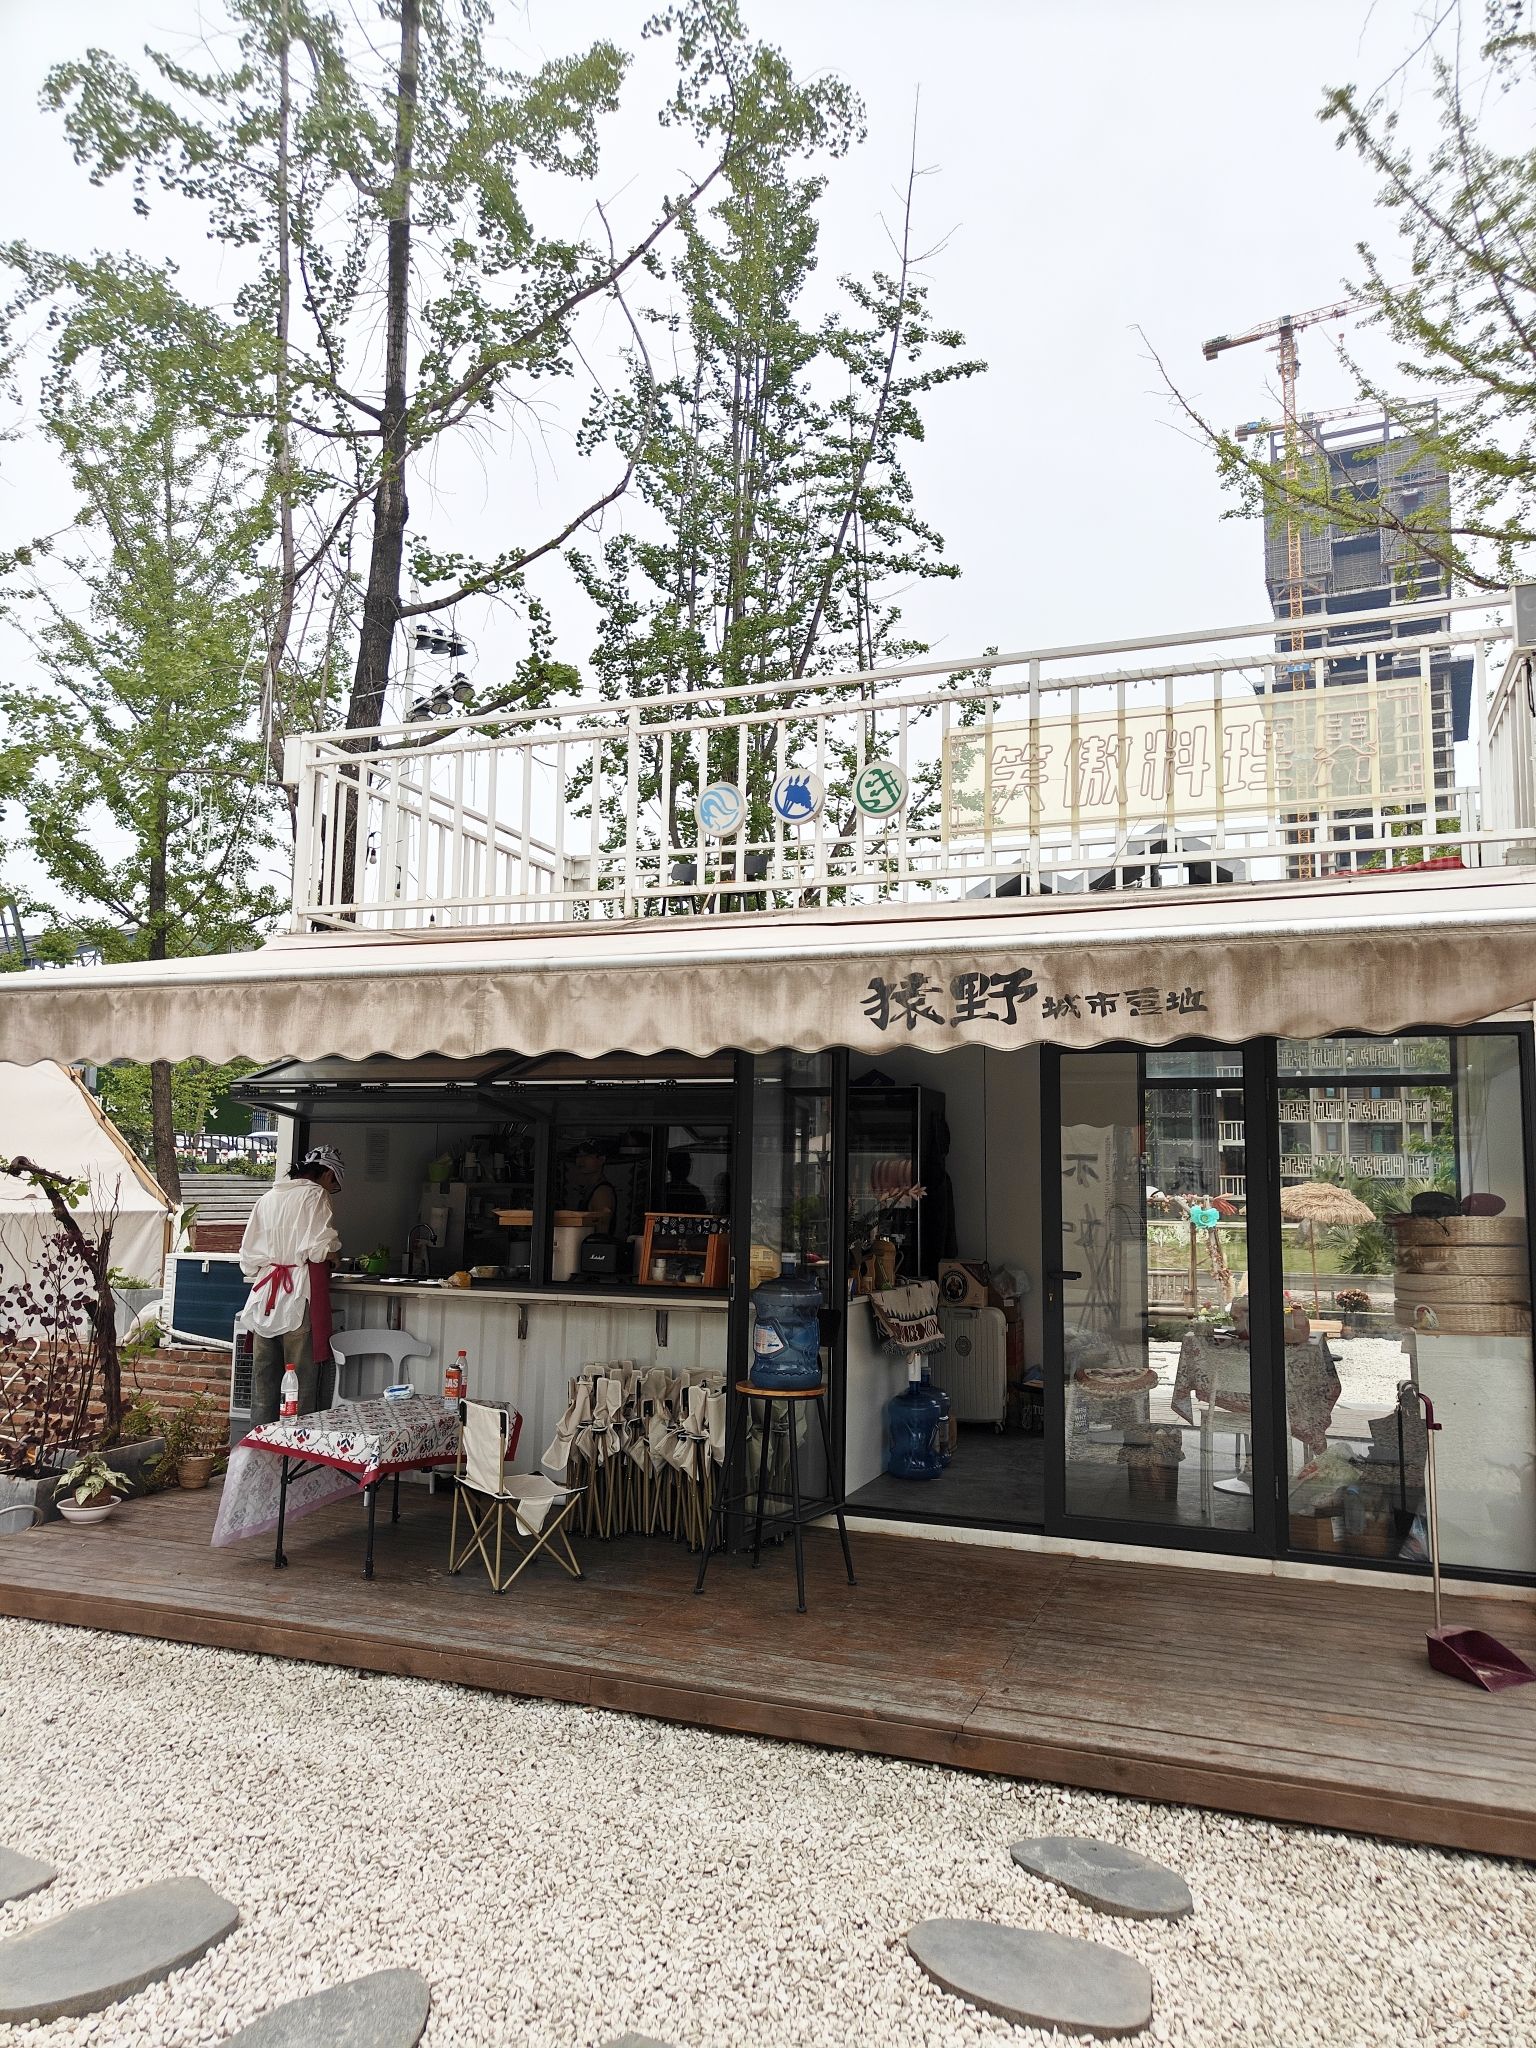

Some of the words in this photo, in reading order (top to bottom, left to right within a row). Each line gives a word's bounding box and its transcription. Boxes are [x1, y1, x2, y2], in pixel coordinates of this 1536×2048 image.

[990, 708, 1378, 816] 笑傲料理界
[859, 967, 1039, 1031] 猿野
[1042, 987, 1208, 1020] 城市营地
